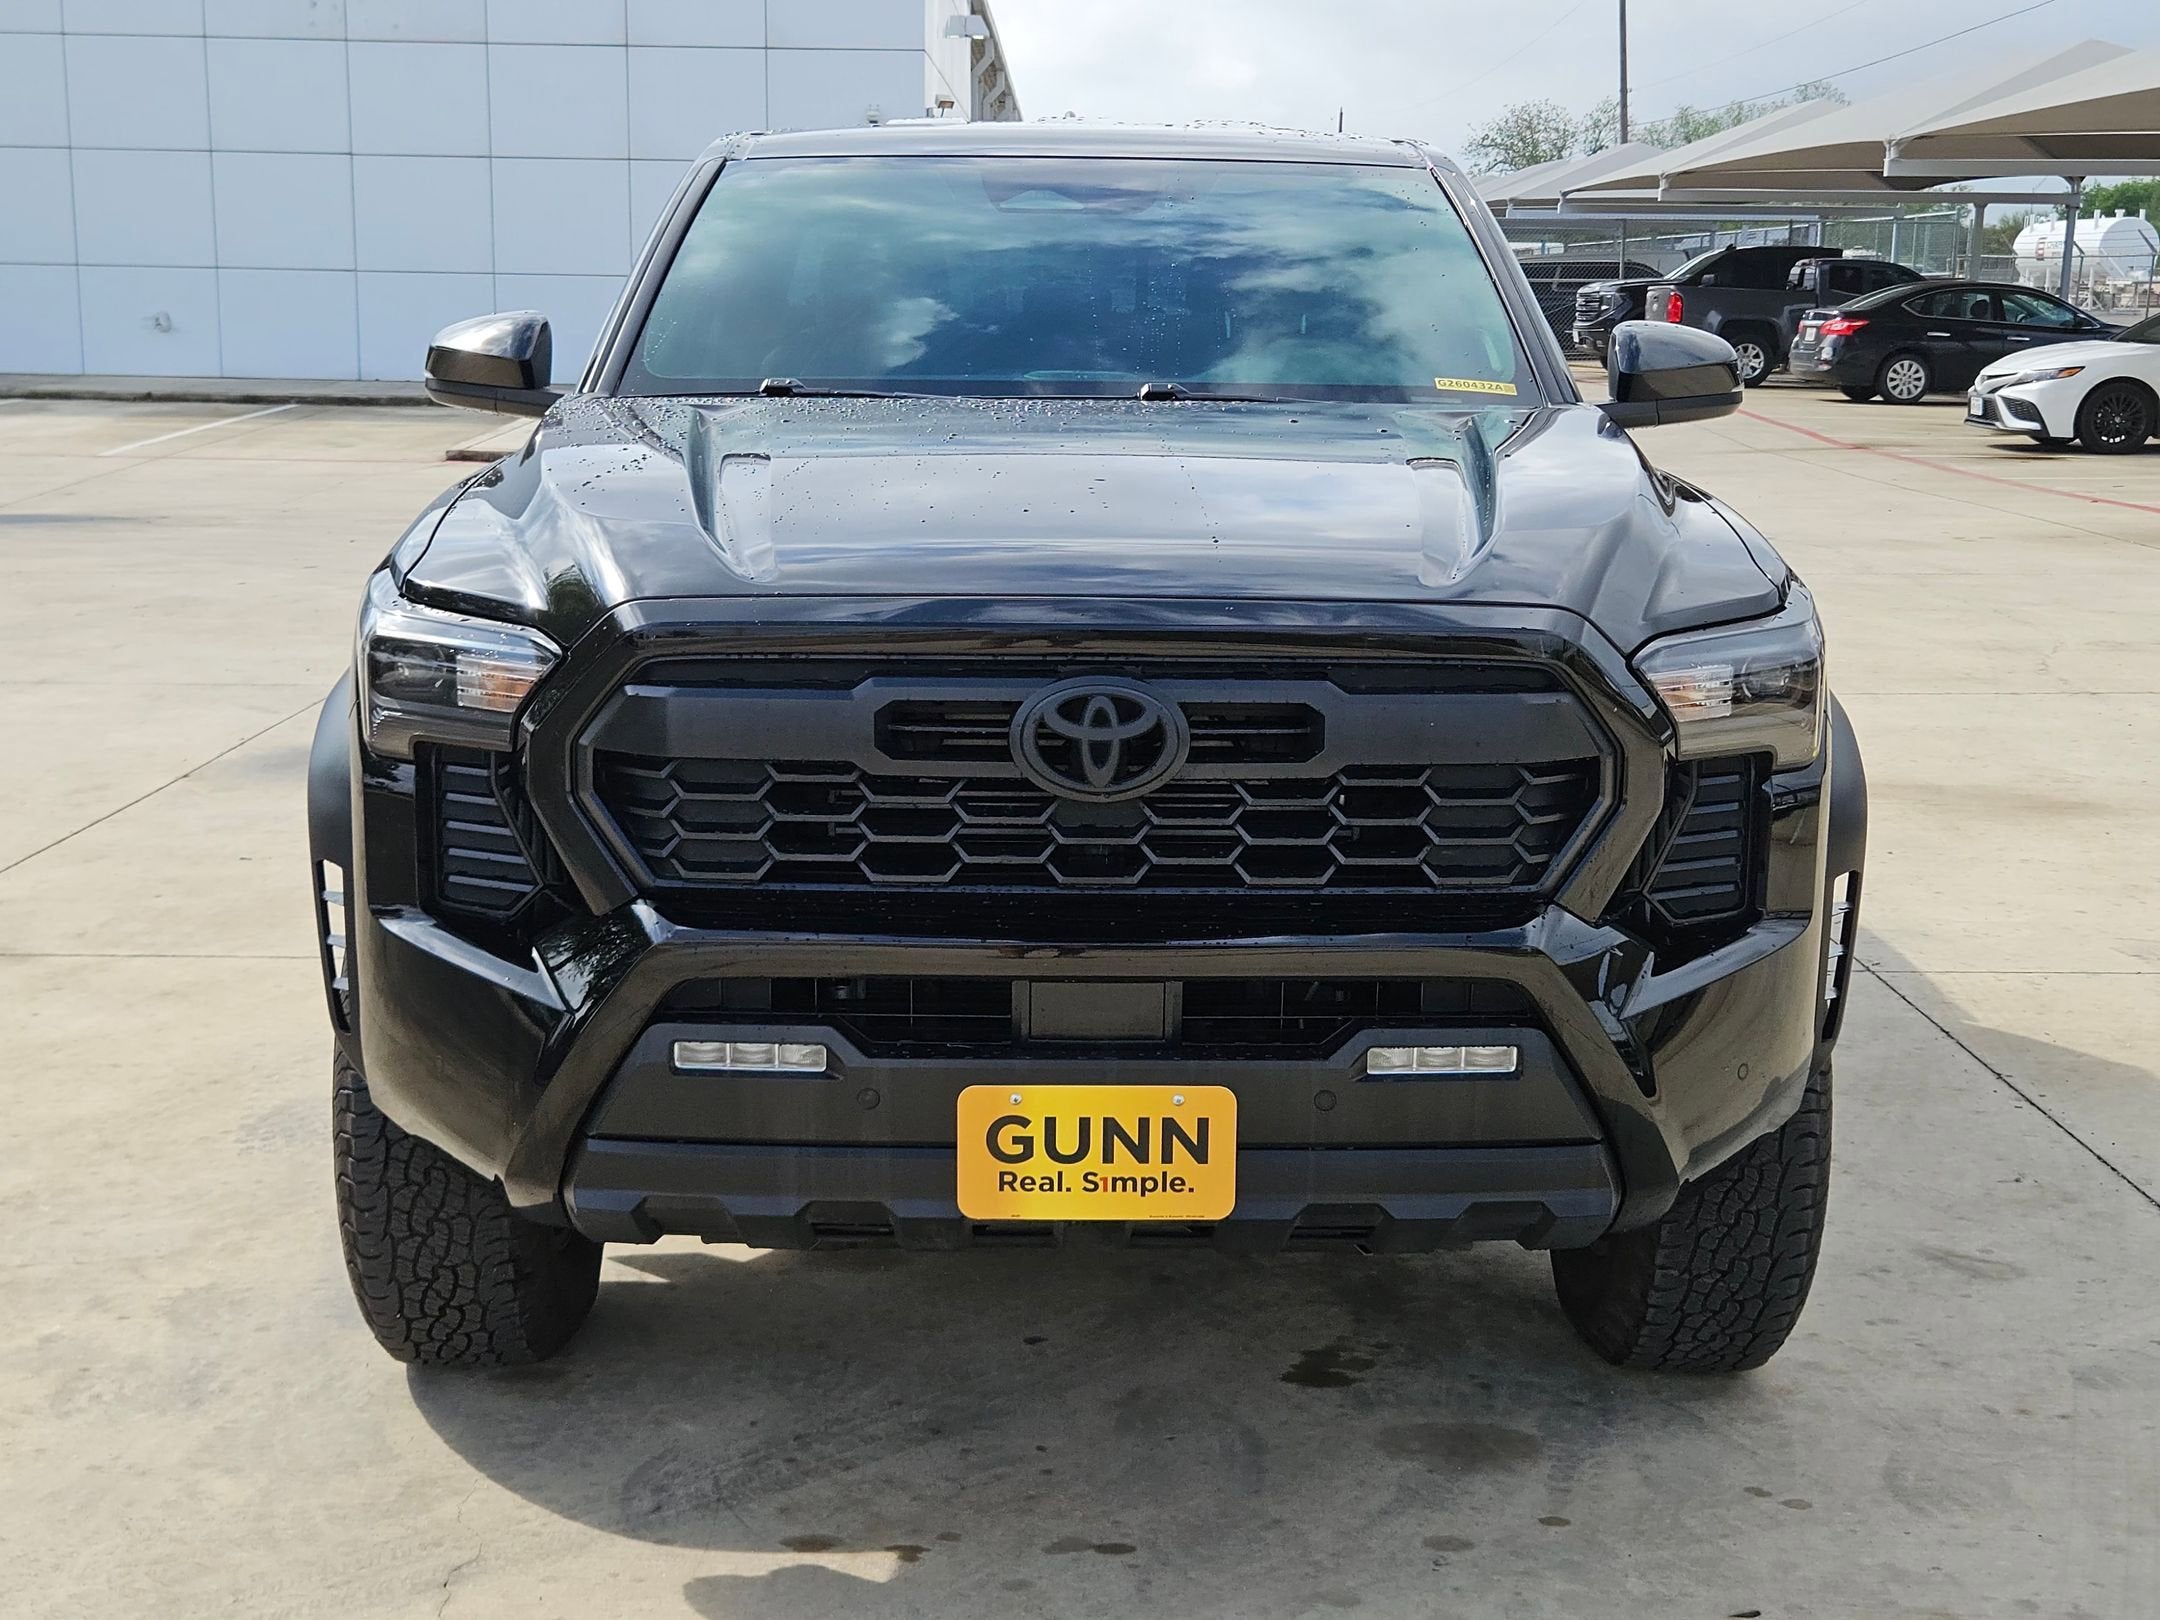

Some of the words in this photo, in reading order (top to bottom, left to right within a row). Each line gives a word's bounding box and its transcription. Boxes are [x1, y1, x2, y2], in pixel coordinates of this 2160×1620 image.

[1438, 379, 1503, 391] G260432A
[986, 1115, 1210, 1164] GUNN
[998, 1171, 1072, 1192] Real.
